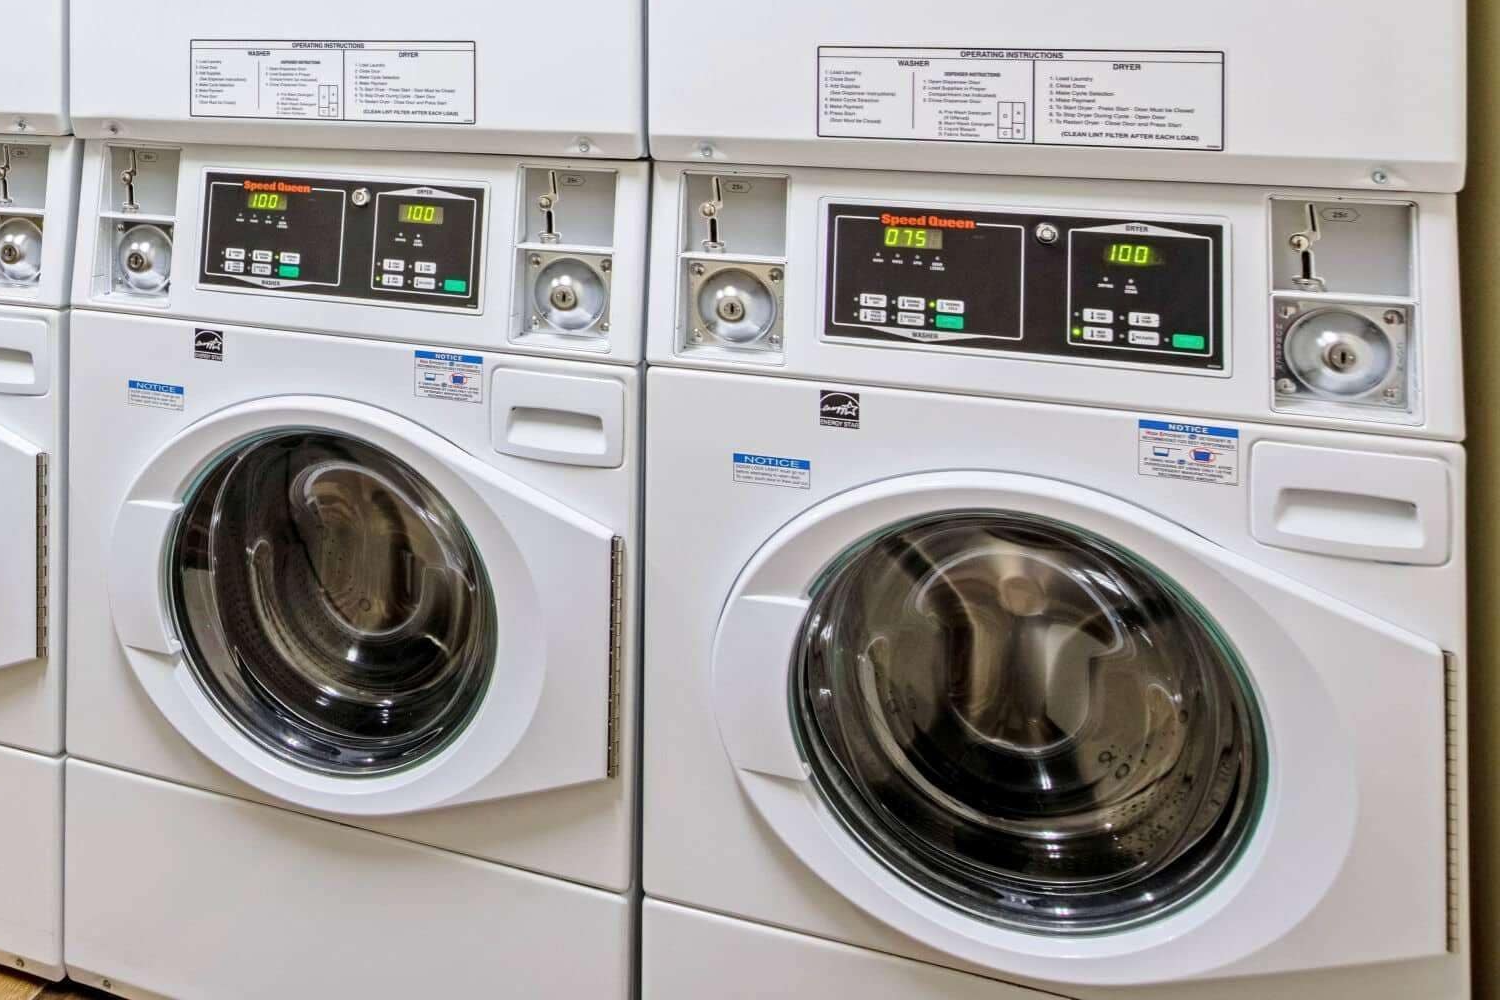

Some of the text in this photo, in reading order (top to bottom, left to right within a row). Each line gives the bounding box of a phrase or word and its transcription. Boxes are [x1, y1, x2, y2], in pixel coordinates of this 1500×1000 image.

[960, 51, 1064, 60] OPERATING INSTRUCTIONS
[897, 59, 930, 67] WASHER
[1112, 63, 1141, 71] DRYER
[244, 180, 311, 194] Speed Queen
[252, 193, 278, 209] 100
[407, 205, 435, 222] 100
[881, 213, 976, 229] Speed Queen
[1125, 225, 1149, 233] DRYER
[885, 228, 927, 247] 075
[1109, 244, 1149, 264] 100
[911, 331, 939, 339] WASHER
[435, 353, 463, 361] NOTICE
[136, 382, 177, 393] NOTICE
[820, 418, 860, 429] ENERGY STAR
[1167, 423, 1209, 434] NOTICE
[744, 456, 799, 468] NOTICE
